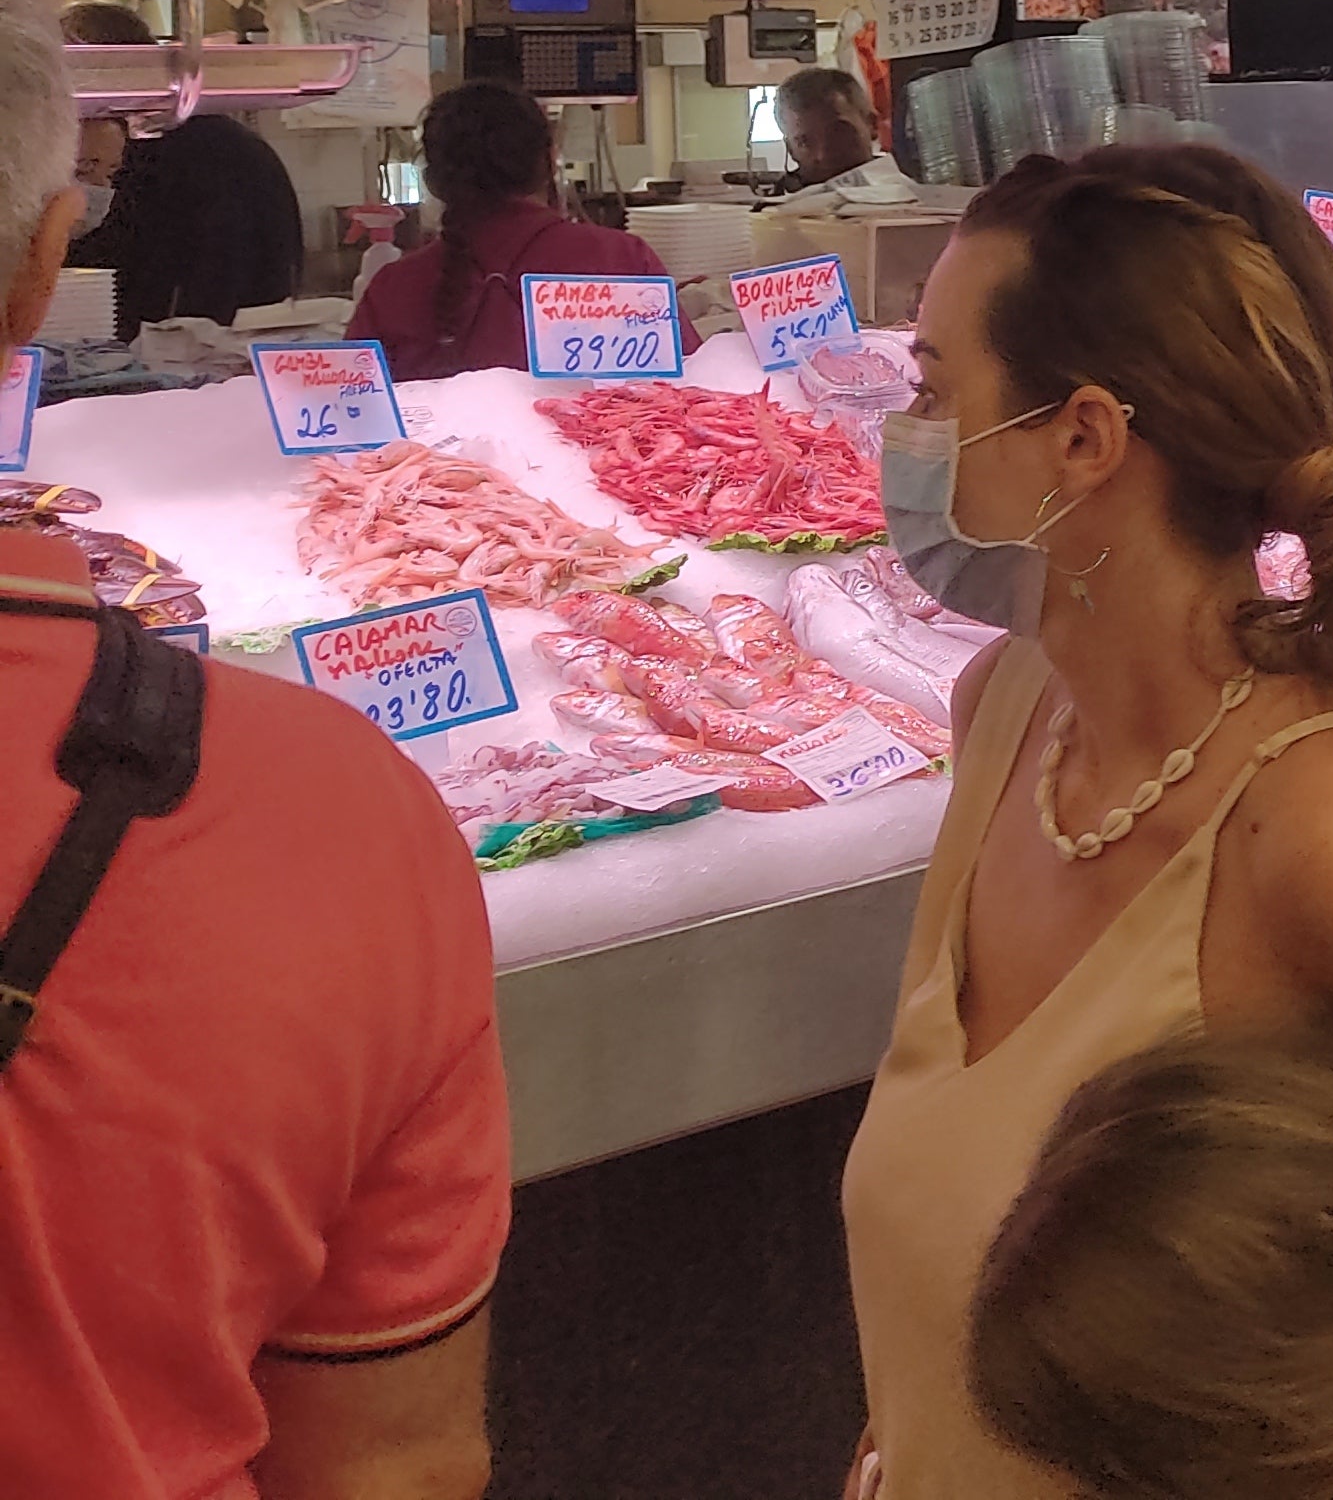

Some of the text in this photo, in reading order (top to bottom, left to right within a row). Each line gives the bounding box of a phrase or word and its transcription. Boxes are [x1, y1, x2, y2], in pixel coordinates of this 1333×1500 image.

[919, 28, 931, 44] 25
[535, 282, 612, 304] GAMBA
[274, 352, 332, 375] GAMBA
[314, 612, 448, 661] CALAMAR
